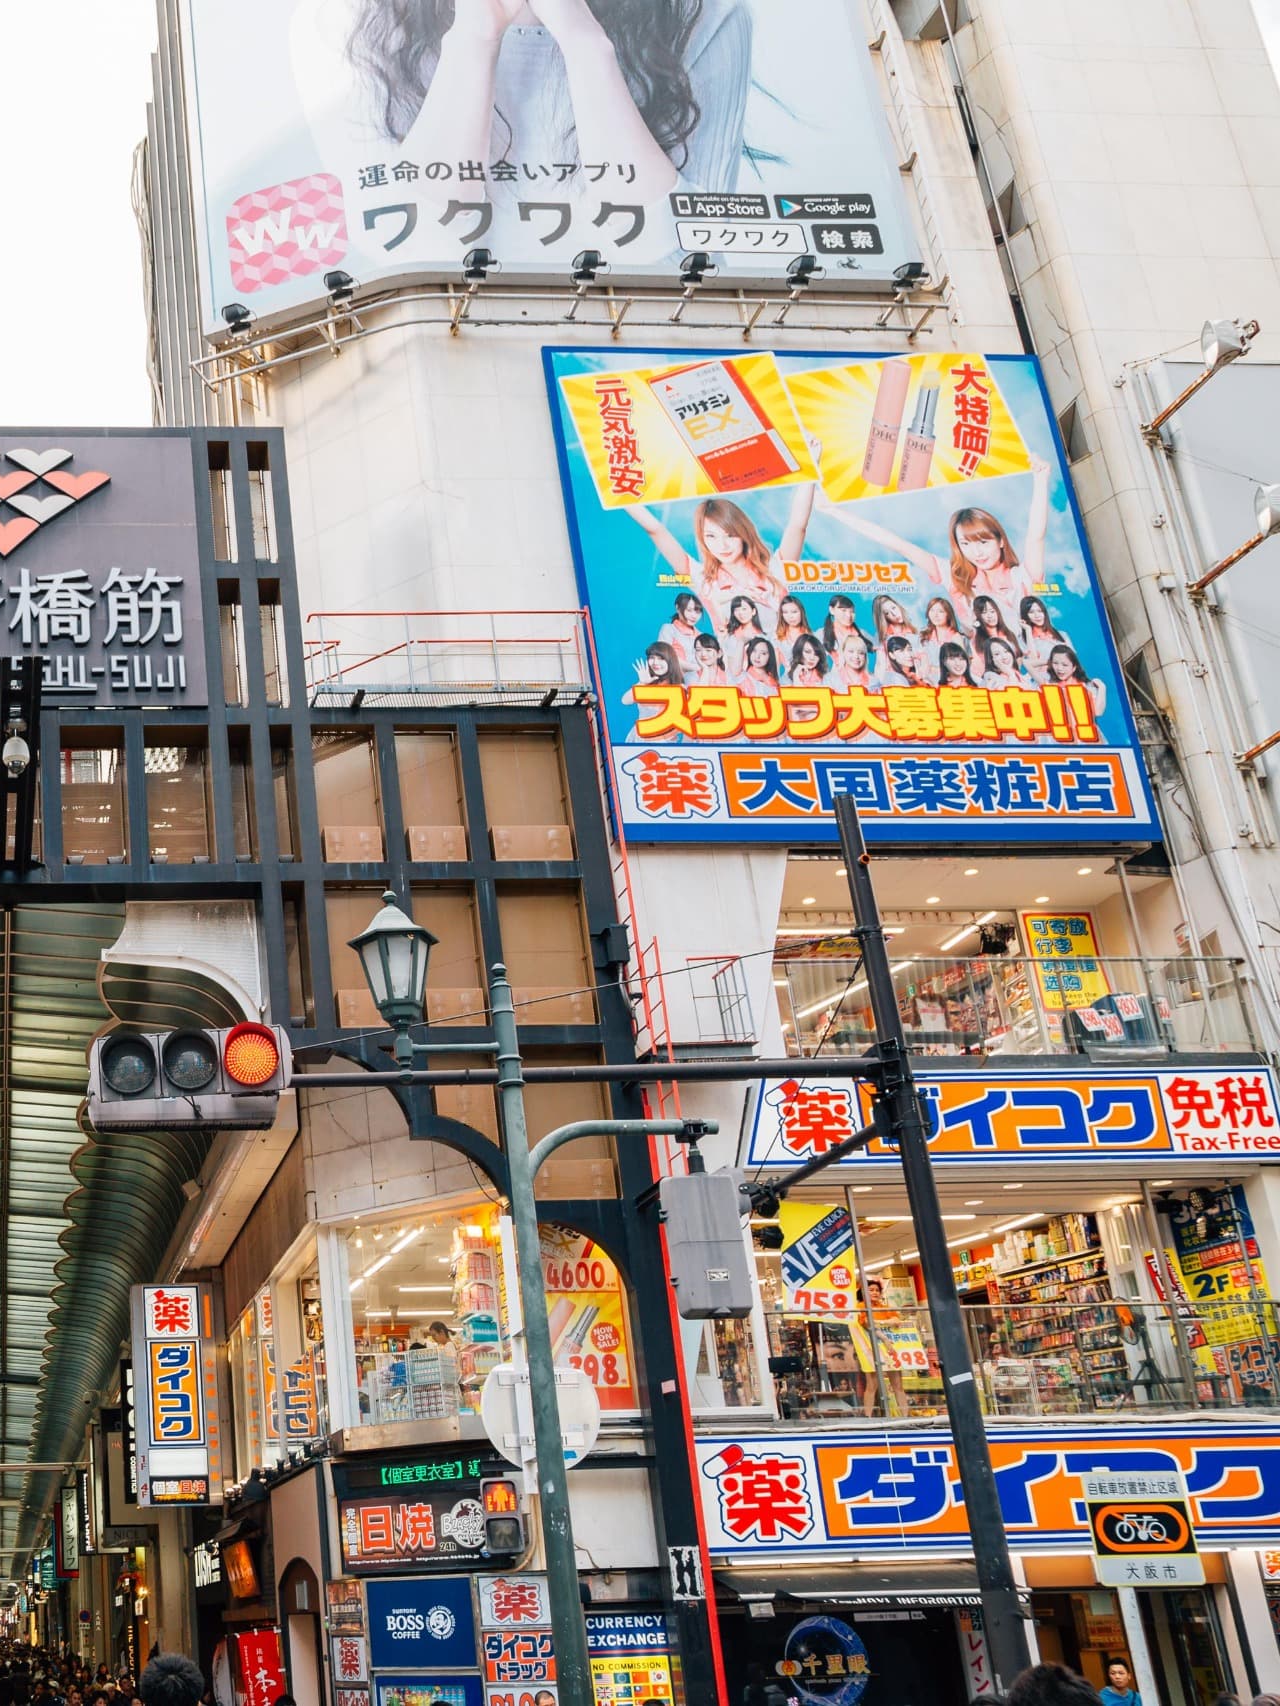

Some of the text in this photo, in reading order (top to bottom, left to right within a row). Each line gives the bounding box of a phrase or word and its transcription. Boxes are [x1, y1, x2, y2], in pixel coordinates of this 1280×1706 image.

[357, 159, 638, 190] 運命の出会いアプリ
[695, 203, 765, 217] App Store
[804, 202, 871, 215] Google play
[361, 200, 648, 251] ワクワク
[693, 229, 789, 247] ワクワク
[821, 230, 874, 249] 検索
[674, 393, 731, 420] アリナミン
[683, 405, 741, 441] EX
[872, 427, 897, 441] DHC
[594, 378, 645, 497] 元気激安
[907, 439, 932, 453] DHC
[783, 562, 913, 583] DDプリンセス
[632, 684, 1099, 743] スタッフ大募集中!!
[637, 757, 718, 817] 薬
[737, 759, 1119, 814] 大国薬粧店
[1031, 918, 1088, 935] 可寄放
[1035, 937, 1073, 954] 行李
[1165, 1077, 1274, 1130] 免税
[781, 1083, 854, 1155] 薬
[1174, 1133, 1280, 1151] Tax-Free
[812, 1222, 827, 1237] EVE
[823, 1208, 846, 1226] QUICK
[782, 1232, 834, 1288] EVE
[546, 1261, 606, 1288] 4600
[1193, 1273, 1229, 1298] 2F
[153, 1290, 191, 1332] 薬
[794, 1290, 849, 1319] 758
[594, 1325, 614, 1336] NOW
[598, 1333, 613, 1342] ON
[157, 1345, 194, 1438] ダイコク
[722, 1453, 812, 1540] 薬
[1088, 1481, 1179, 1496] 自転車放置禁止区域
[360, 1503, 436, 1554] 日焼
[1126, 1565, 1178, 1579] 大阪市
[493, 1582, 538, 1622] 薬
[386, 1615, 424, 1631] BOSS
[392, 1631, 421, 1639] COFFEE
[586, 1616, 662, 1629] CURRENCY
[486, 1634, 554, 1660] ダイコク
[588, 1633, 666, 1647] EXCHANGE
[340, 1638, 360, 1679] 薬
[496, 1662, 548, 1680] ドラッグ
[803, 1654, 871, 1675] 千里眼
